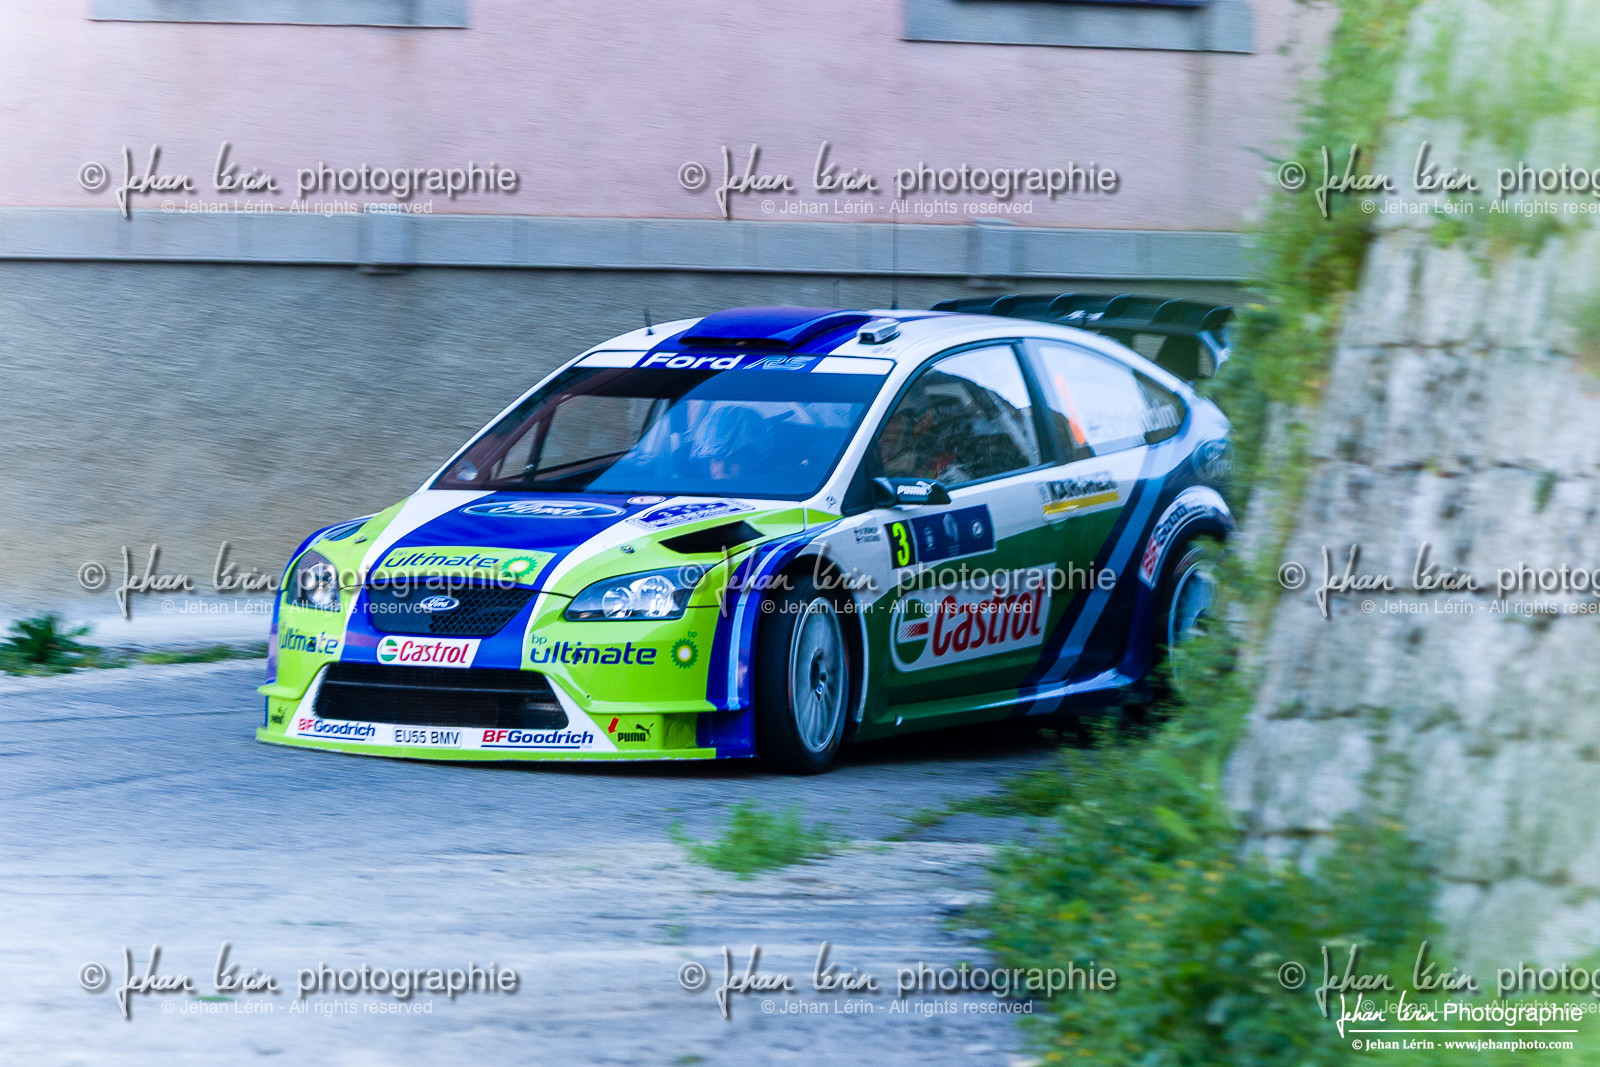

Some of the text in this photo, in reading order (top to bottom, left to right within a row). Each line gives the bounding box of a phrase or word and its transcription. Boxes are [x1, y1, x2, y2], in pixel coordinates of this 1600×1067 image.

[639, 352, 748, 370] Ford
[891, 522, 910, 567] 3
[384, 552, 500, 568] ultimate
[427, 596, 450, 608] Ford
[932, 578, 1045, 657] Castrol
[280, 627, 338, 655] ultimate
[531, 634, 548, 646] bp
[399, 640, 469, 664] Castrol
[530, 641, 658, 665] ultimate
[299, 719, 376, 738] BFGoodrich
[394, 729, 460, 745] EU55 BMV
[482, 729, 594, 745] BFGoodrich
[617, 732, 646, 742] PUMA
